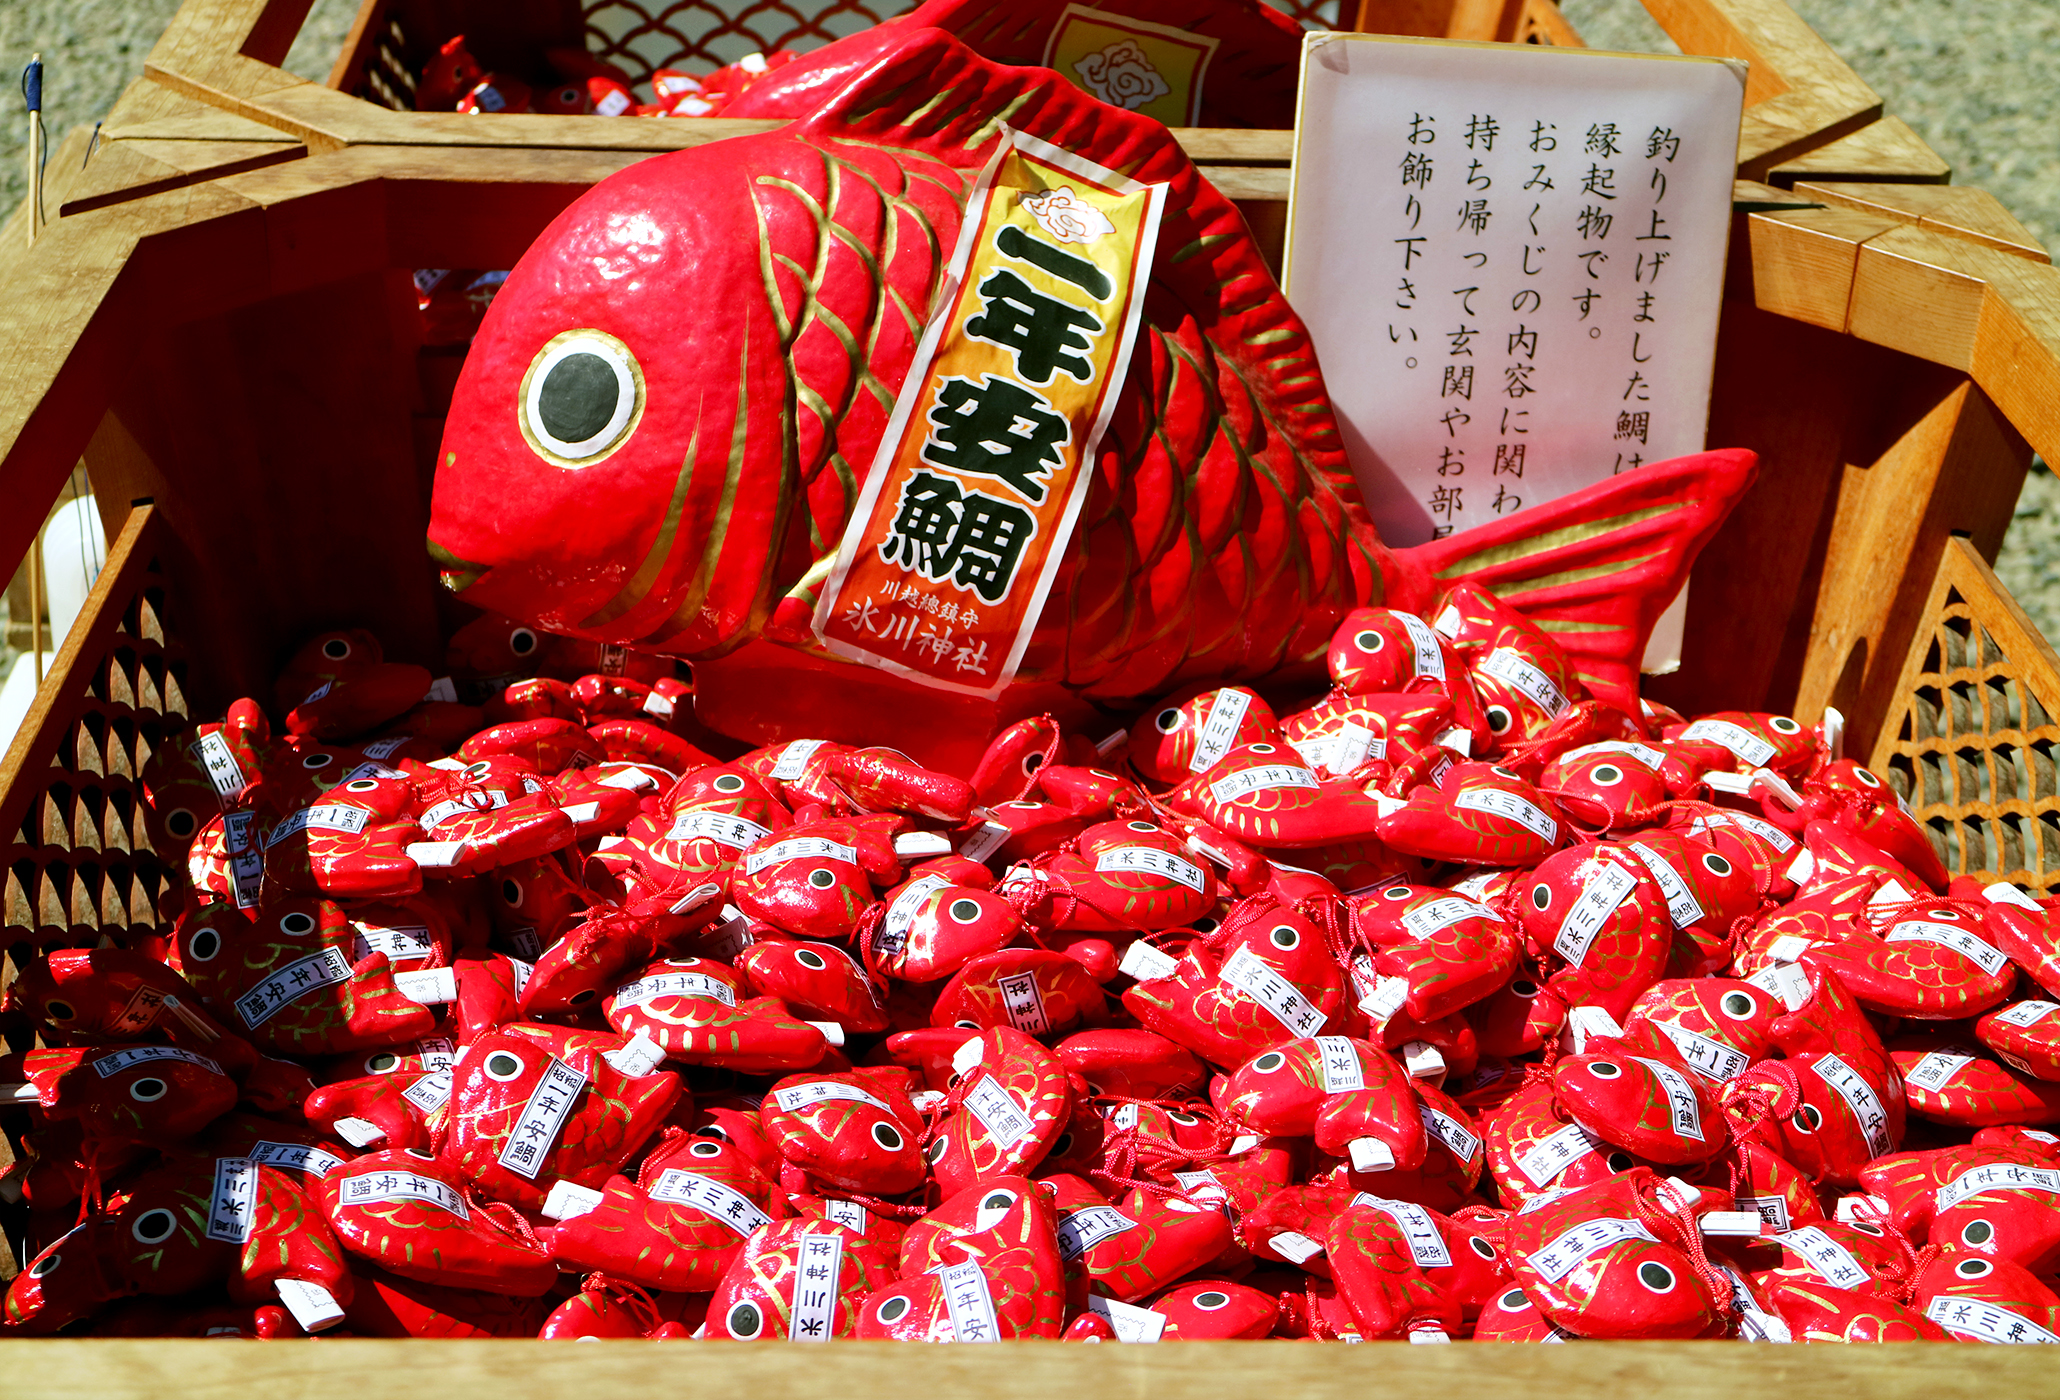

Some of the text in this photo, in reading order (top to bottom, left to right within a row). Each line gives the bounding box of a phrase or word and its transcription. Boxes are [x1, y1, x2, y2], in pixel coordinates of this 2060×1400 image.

[1389, 112, 1435, 370] お飾り下さい。
[1572, 122, 1623, 339] 縁起物です。
[1491, 119, 1558, 513] おみくじの内容に関わ
[882, 226, 1114, 602] 一年安鯛
[844, 597, 988, 676] 氷川神社
[247, 961, 326, 1018] 一年安鯛
[1006, 981, 1041, 1036] 川神社
[509, 1084, 568, 1166] 一年安鯛
[800, 1240, 832, 1336] 氷川神社
